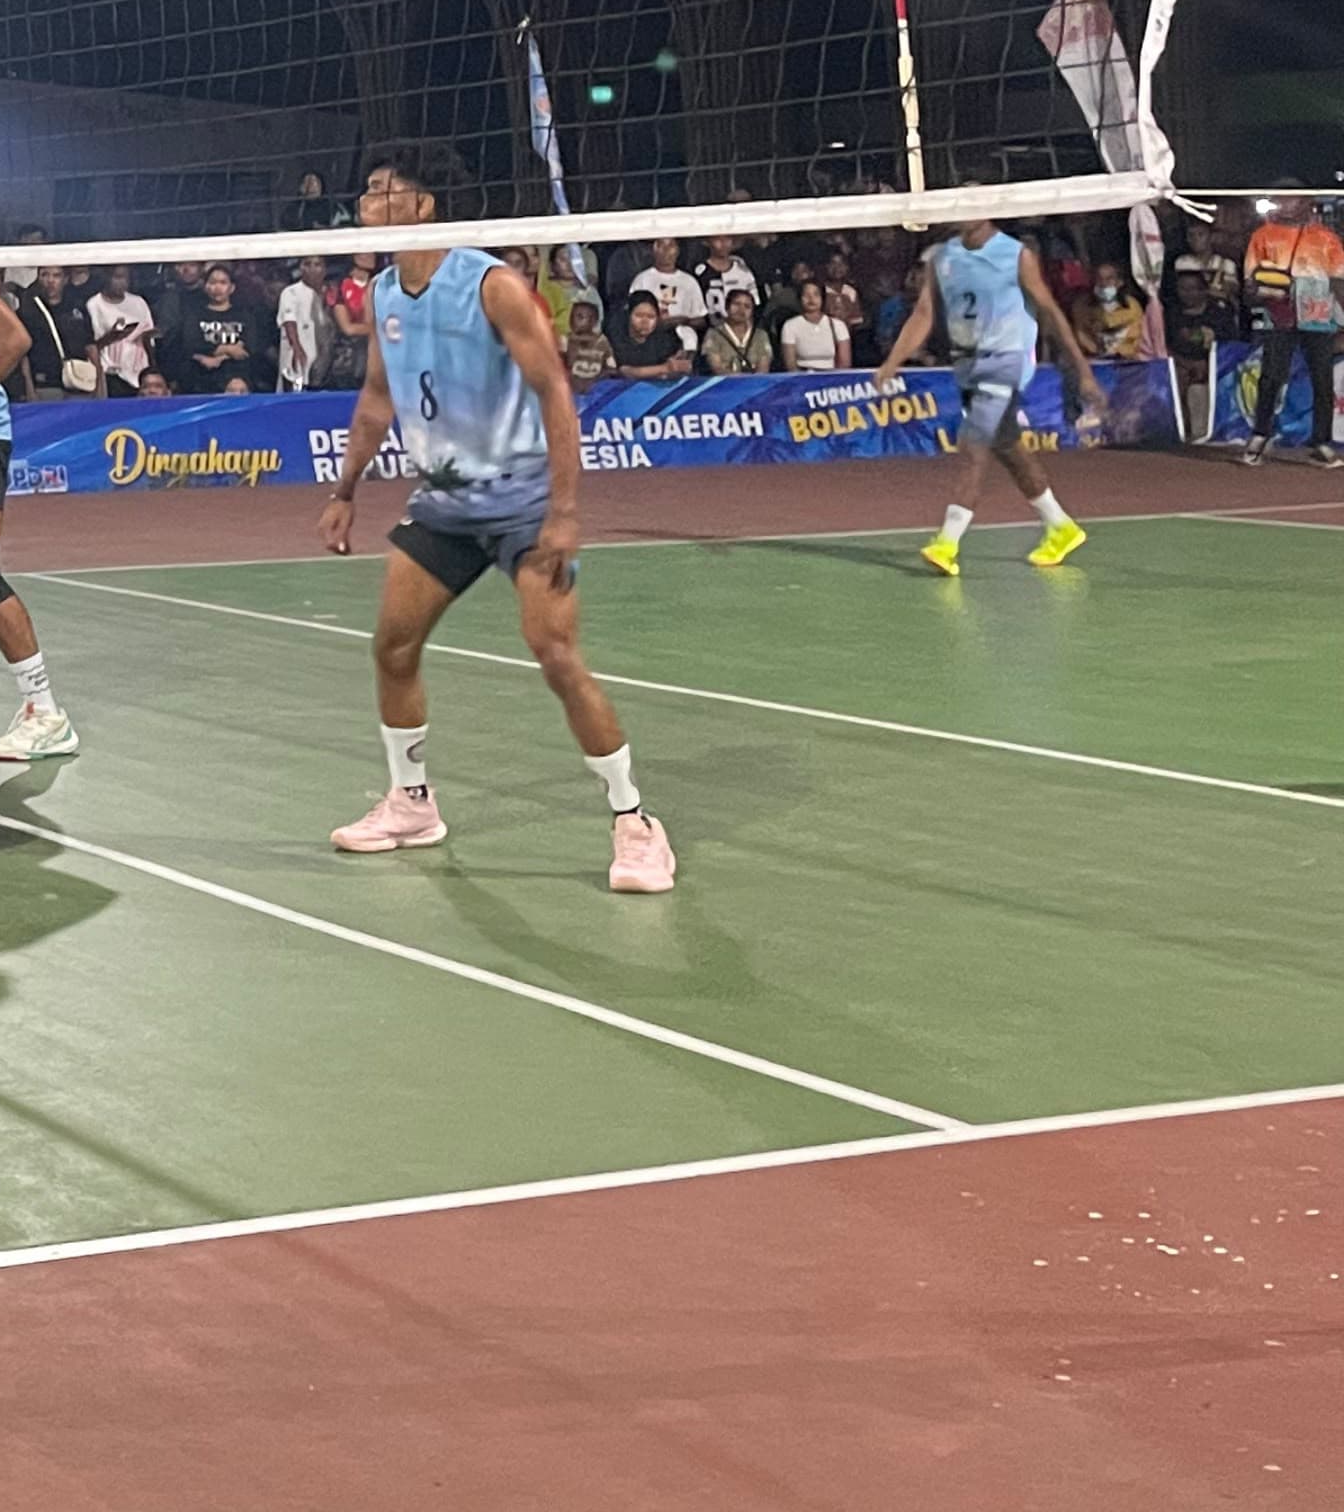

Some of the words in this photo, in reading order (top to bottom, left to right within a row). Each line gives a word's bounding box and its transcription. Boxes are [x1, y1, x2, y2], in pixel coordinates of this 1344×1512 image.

[962, 291, 978, 319] 2
[419, 369, 439, 421] 8
[642, 411, 764, 441] DAERAH
[788, 405, 868, 443] BOLA
[867, 391, 938, 427] VOLI
